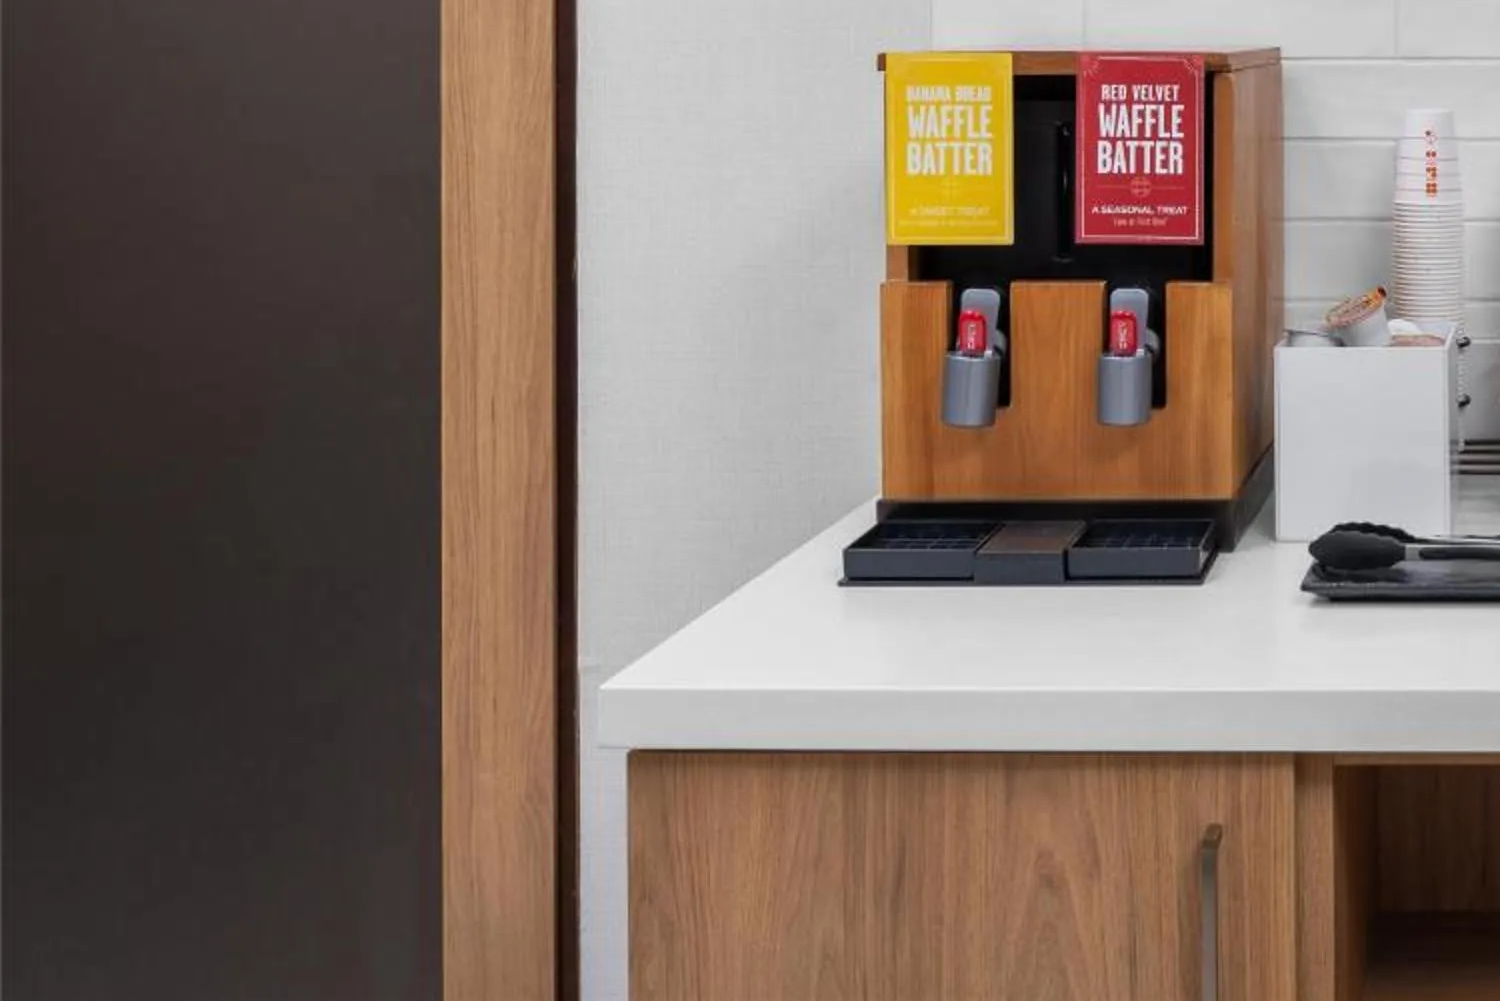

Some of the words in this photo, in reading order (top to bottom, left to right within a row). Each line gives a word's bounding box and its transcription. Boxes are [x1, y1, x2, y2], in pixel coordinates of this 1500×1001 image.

[1101, 85, 1127, 102] RED
[1132, 85, 1180, 102] VELVET
[907, 104, 994, 139] WAFFLE
[1099, 103, 1185, 138] WAFFLE
[906, 142, 993, 176] BATTER
[1097, 140, 1184, 175] BATTER
[1101, 205, 1154, 215] SEASONAL
[1157, 206, 1188, 216] TREAT
